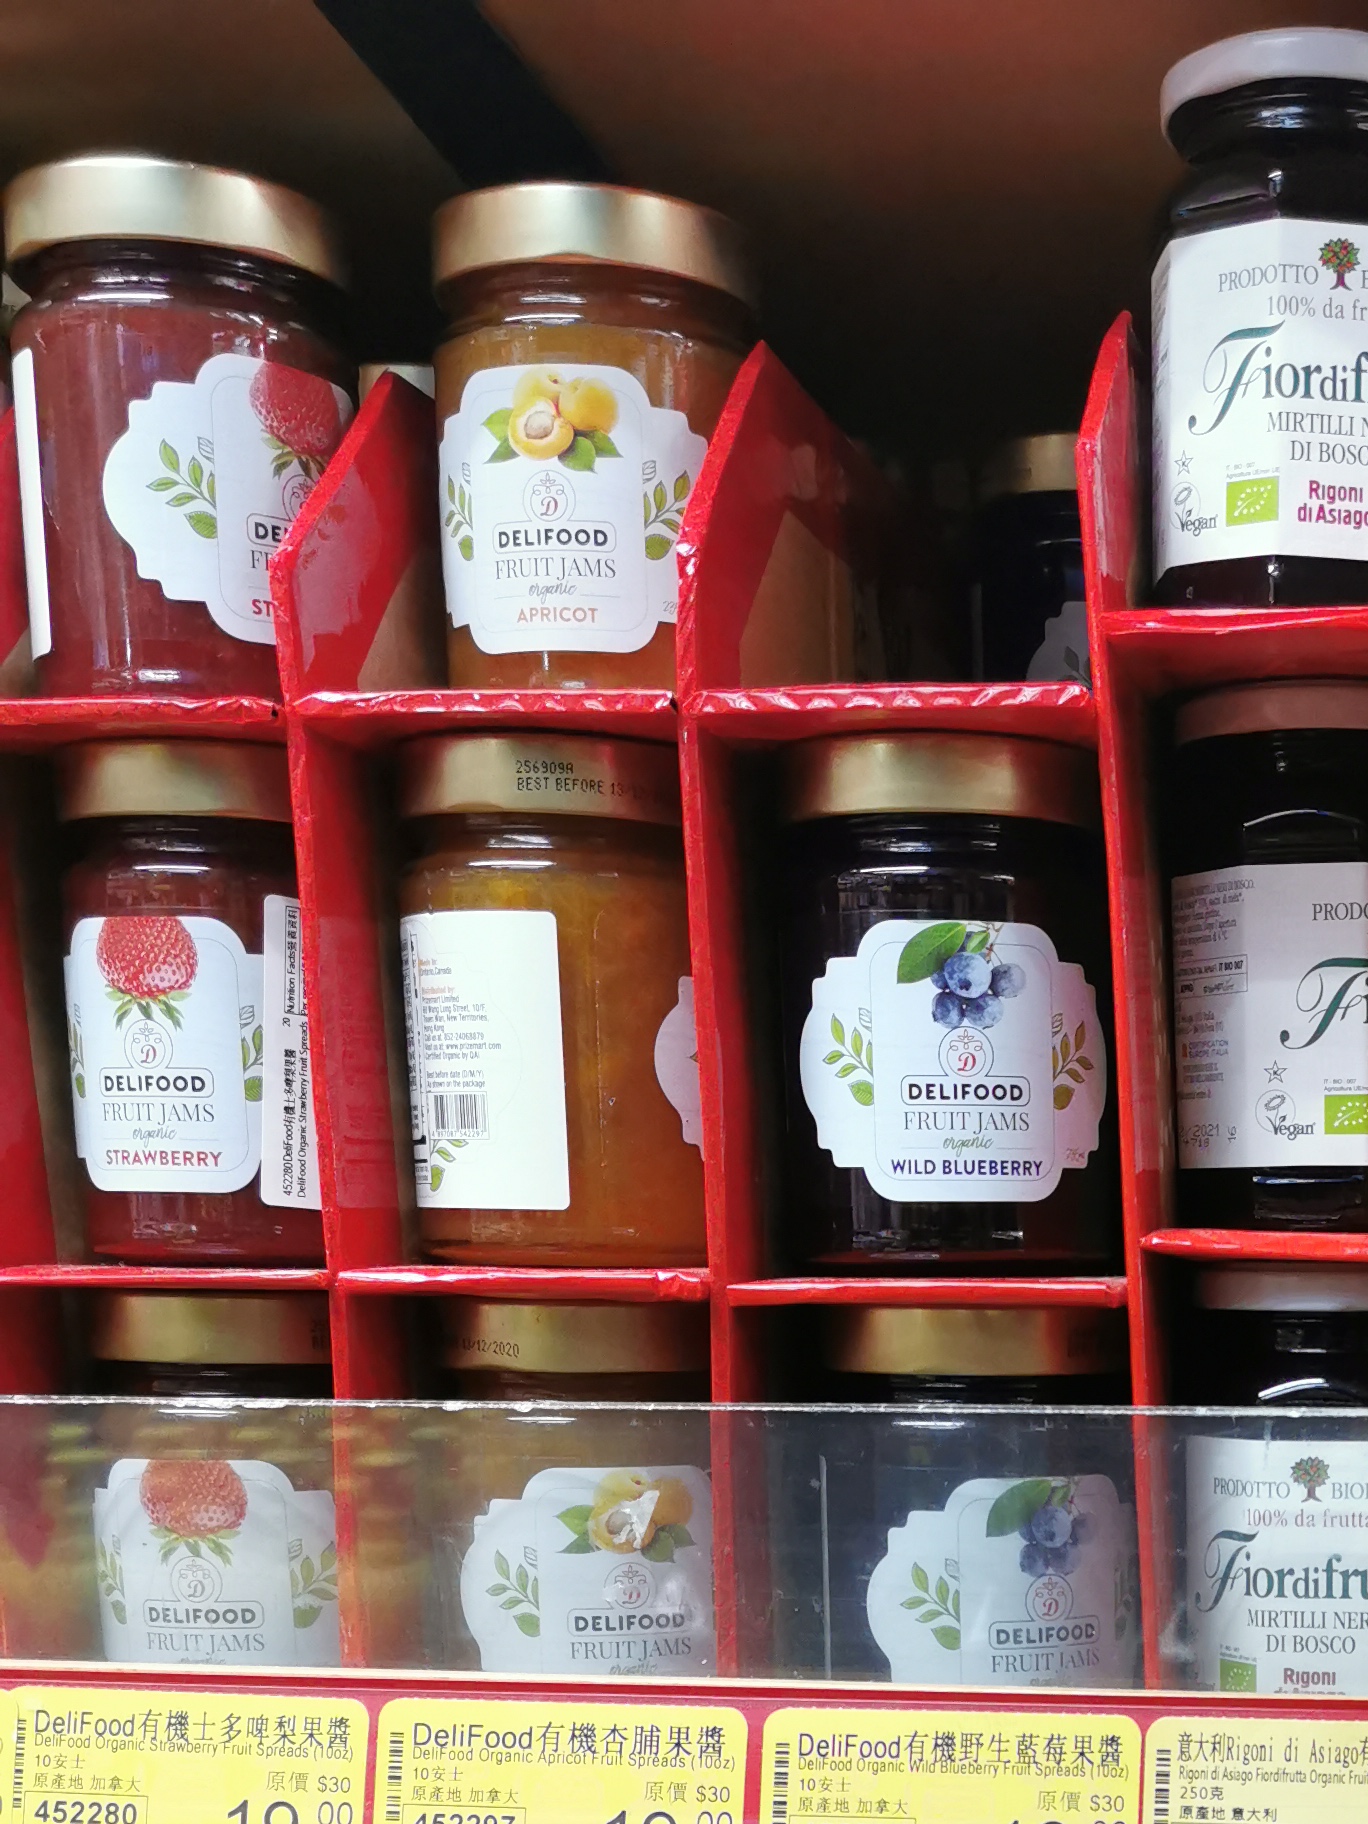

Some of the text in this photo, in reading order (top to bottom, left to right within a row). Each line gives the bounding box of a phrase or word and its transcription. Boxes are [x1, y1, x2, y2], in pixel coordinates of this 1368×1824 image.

[1218, 263, 1319, 292] PRODOTTO
[1267, 296, 1315, 316] 100%
[1324, 298, 1344, 319] da
[1267, 412, 1355, 437] MIRTILLI
[1290, 441, 1313, 462] DI
[1309, 481, 1364, 504] Rigoni
[1298, 505, 1313, 523] di
[498, 529, 608, 548] DELIFOOD
[495, 558, 617, 582] FRUIT JAMS
[529, 582, 576, 602] organic
[517, 608, 598, 624] APRICOT
[517, 777, 604, 794] BEST BEFORE
[104, 1075, 206, 1093] DELIFOOD
[908, 1083, 1023, 1101] DELIFOOD
[103, 1103, 215, 1125] FRUIT JAMS
[904, 1112, 1030, 1134] FRUIT JAMS
[133, 1127, 177, 1141] organic
[943, 1136, 994, 1157] organic
[106, 1150, 222, 1167] STRAWBERRY
[892, 1160, 1042, 1177] WILD BLUEBERRY
[149, 1607, 256, 1624] DELIFOOD
[574, 1614, 685, 1632] DELIFOOD
[147, 1632, 264, 1655] FRUIT JAMS
[1284, 1668, 1335, 1687] Rigoni
[99, 1736, 145, 1753] Organic
[150, 1739, 217, 1758] Strawberry
[223, 1742, 251, 1756] Fruit
[256, 1744, 309, 1760] Spreads
[479, 1748, 685, 1769] Organic Apricot Fruit Spreads
[940, 1762, 999, 1778] Blueberry
